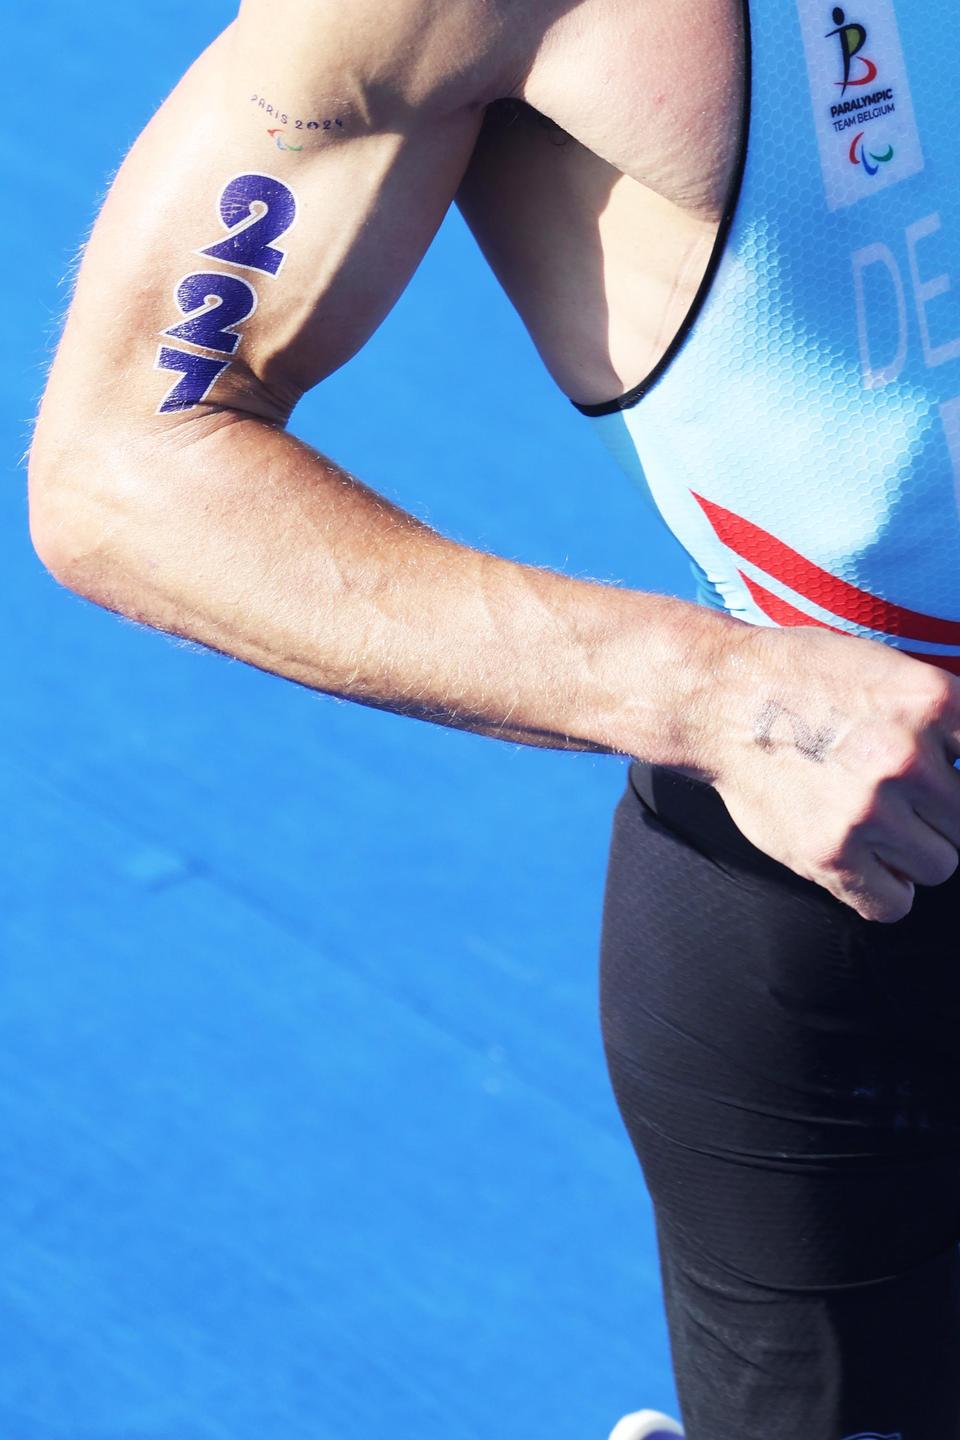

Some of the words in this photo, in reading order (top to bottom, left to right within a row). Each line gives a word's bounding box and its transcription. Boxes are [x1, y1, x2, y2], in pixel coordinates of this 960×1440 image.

[251, 94, 289, 125] PARIS
[295, 118, 343, 130] 2024
[830, 88, 893, 118] PARALYMPIC
[833, 116, 857, 132] TEAM
[857, 103, 896, 124] BELGIUM
